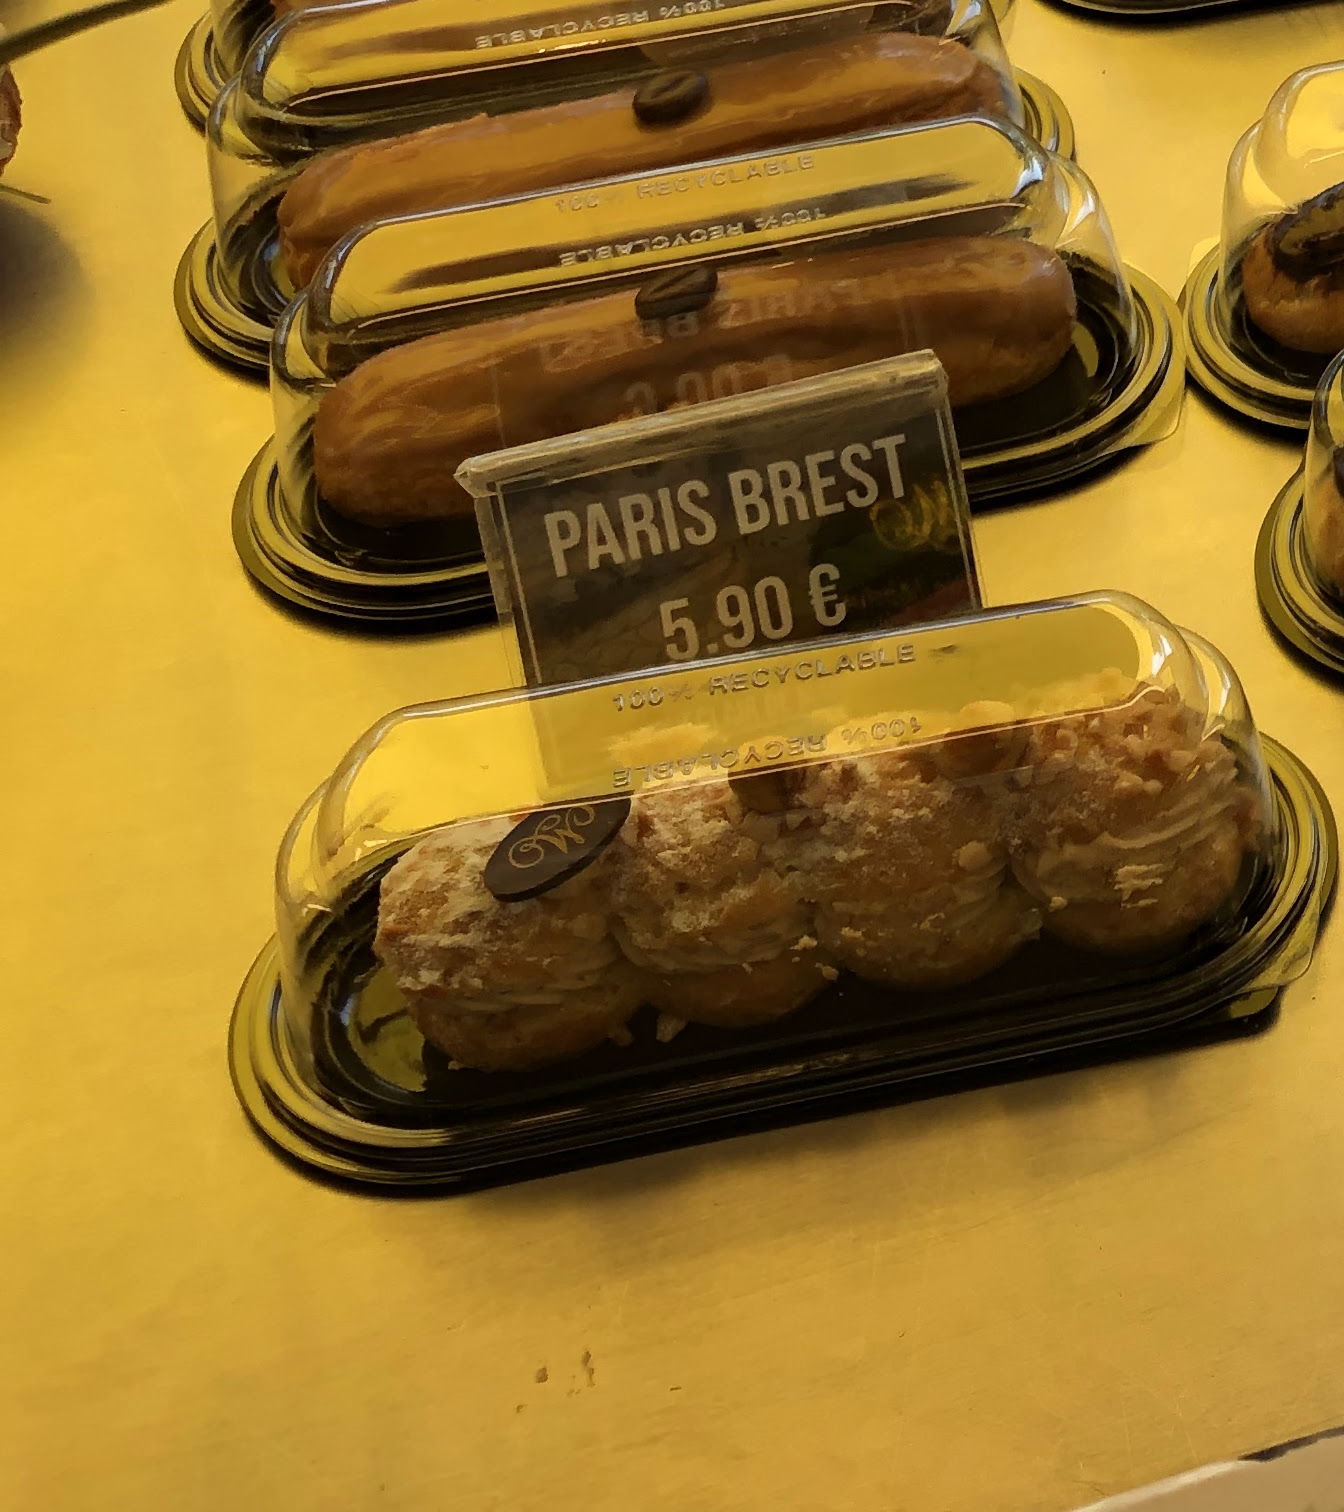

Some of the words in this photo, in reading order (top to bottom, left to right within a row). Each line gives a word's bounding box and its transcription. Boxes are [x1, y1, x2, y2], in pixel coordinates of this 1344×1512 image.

[476, 10, 650, 48] RECYCLABLE
[660, 0, 725, 18] 100%
[637, 154, 816, 198] RECYCLABLE
[756, 208, 828, 231] 100%
[559, 221, 745, 266] RECYCLABLE
[543, 480, 718, 579] PARIS
[727, 433, 910, 536] BREST
[659, 575, 794, 662] 5.90
[808, 563, 847, 628] €
[613, 682, 694, 712] 100%
[707, 642, 917, 695] RECYCLABLE
[842, 716, 923, 743] 100%
[613, 732, 828, 788] RECYCLABLE
